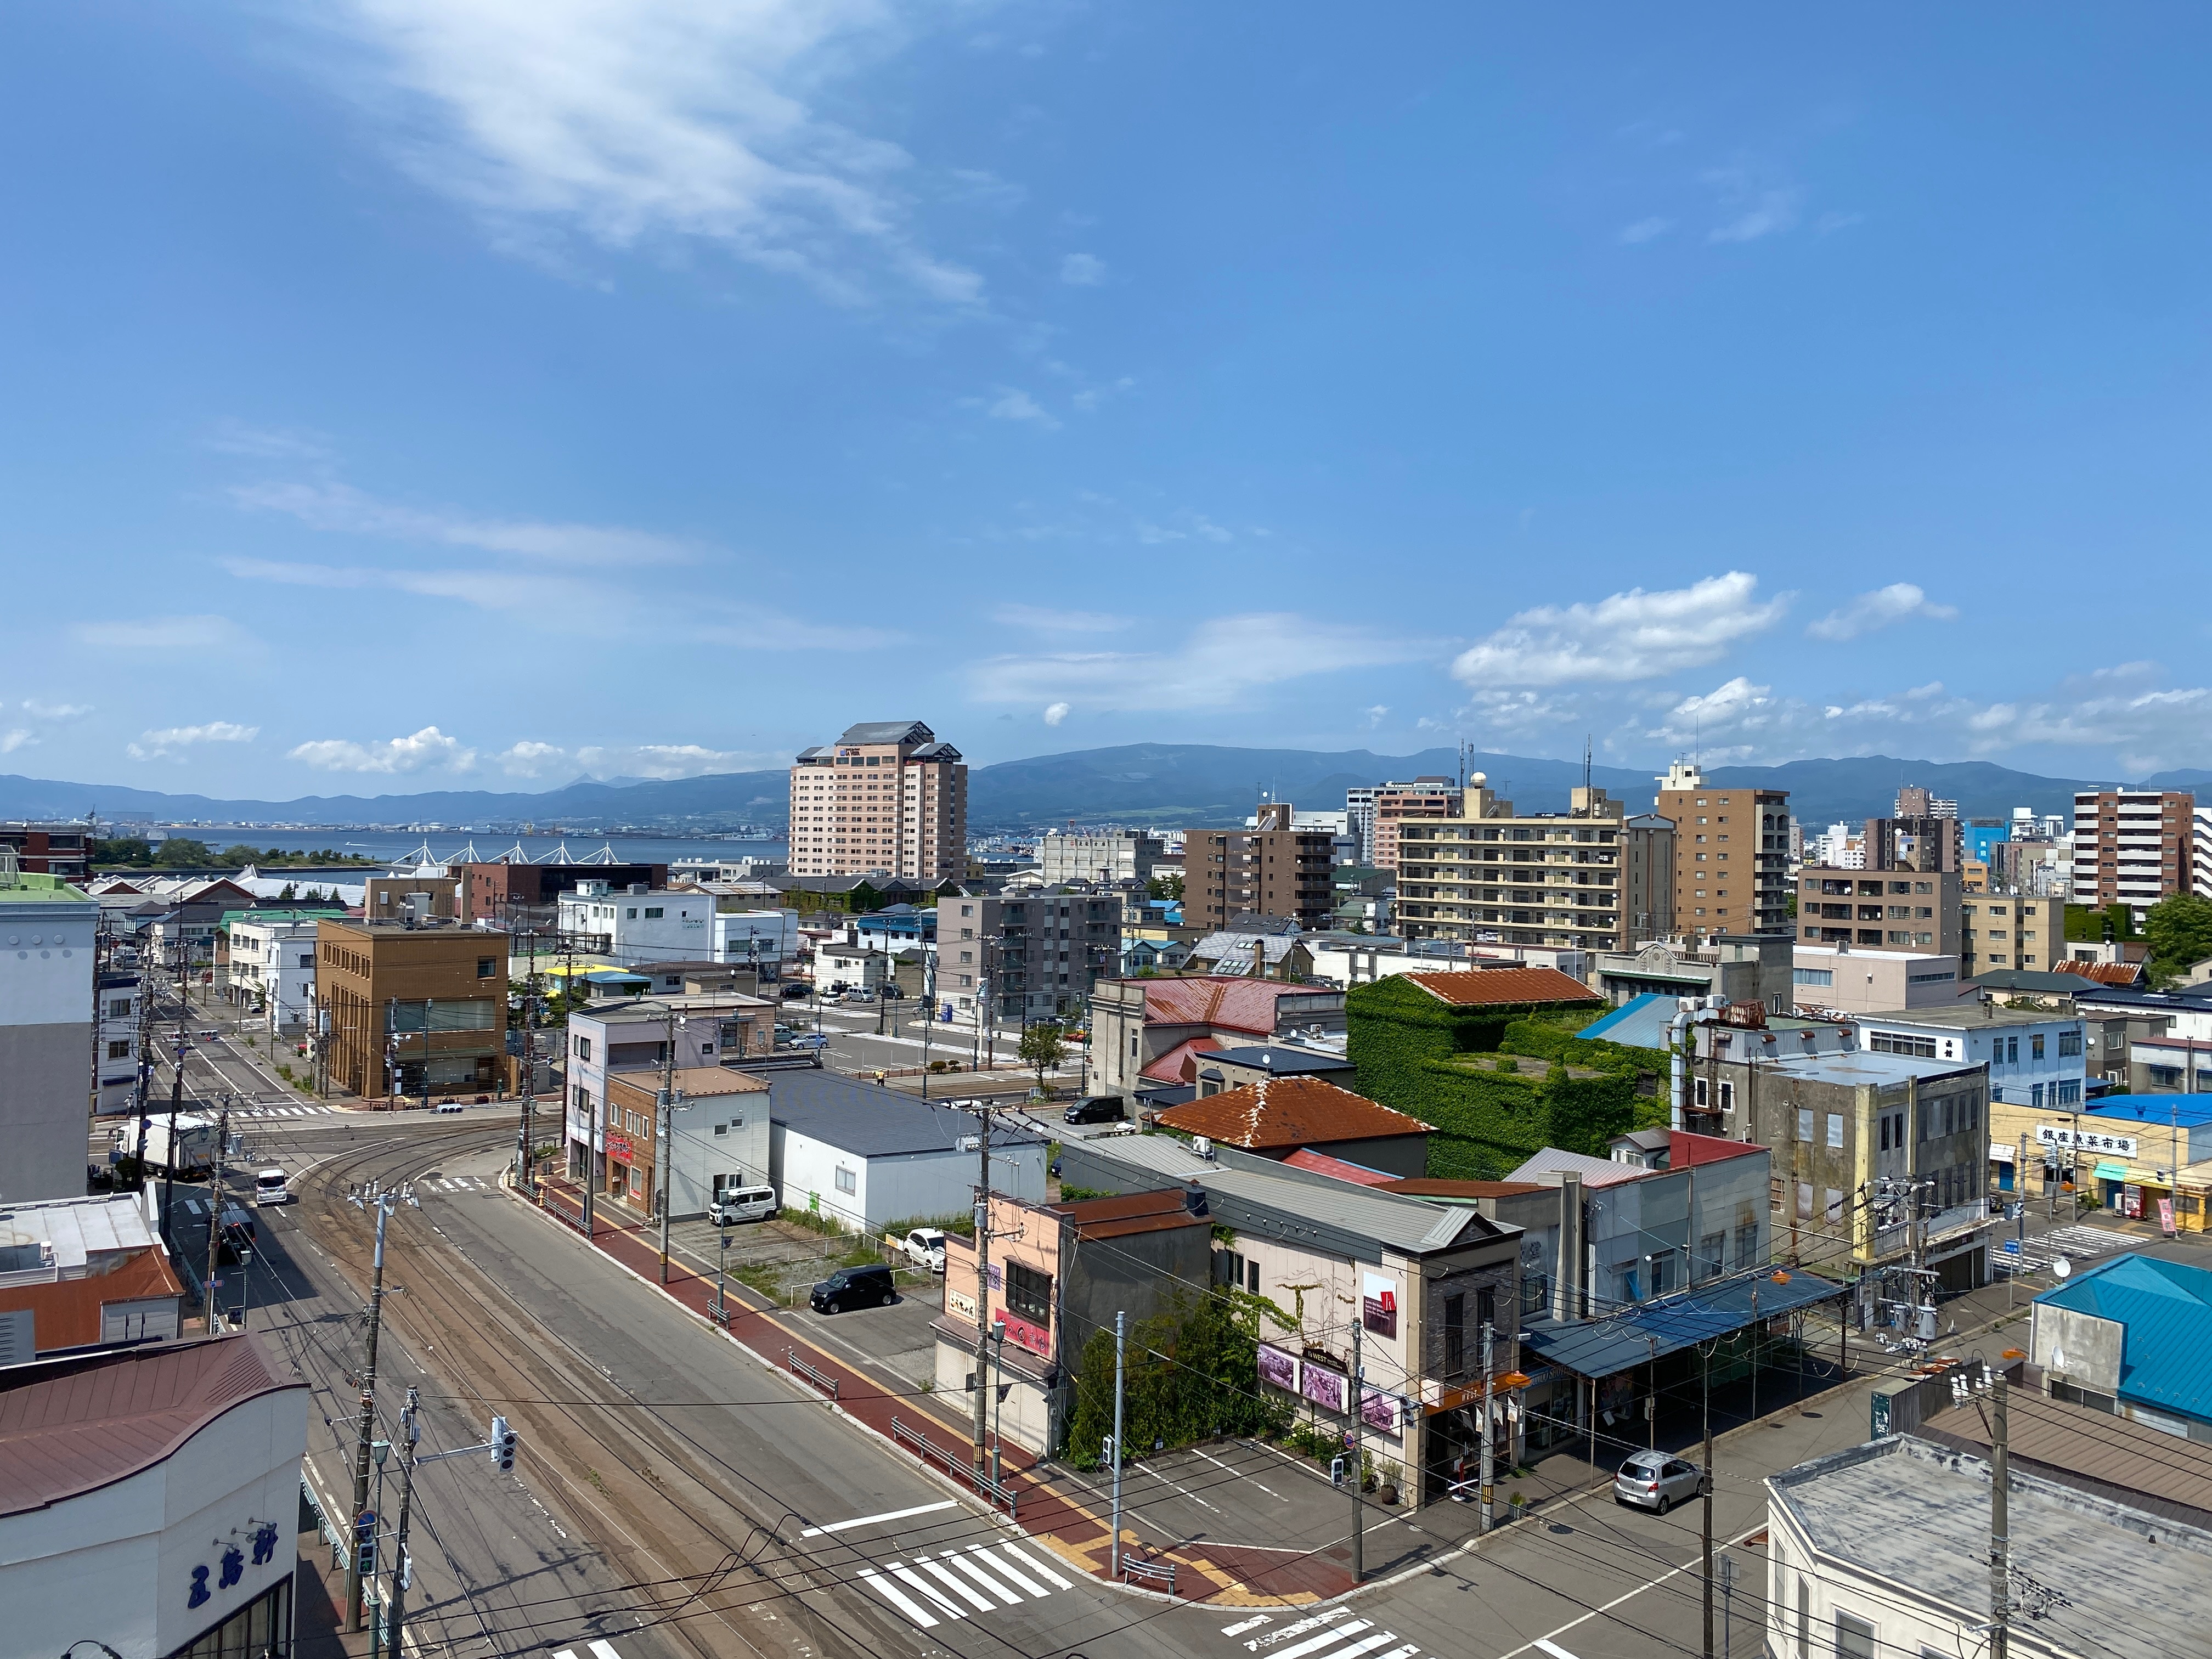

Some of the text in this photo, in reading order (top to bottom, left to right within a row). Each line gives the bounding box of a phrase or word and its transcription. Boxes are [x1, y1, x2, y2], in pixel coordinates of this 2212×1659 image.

[2042, 1129, 2130, 1151] 銀座魚菜市場
[1313, 1352, 1327, 1363] WEST
